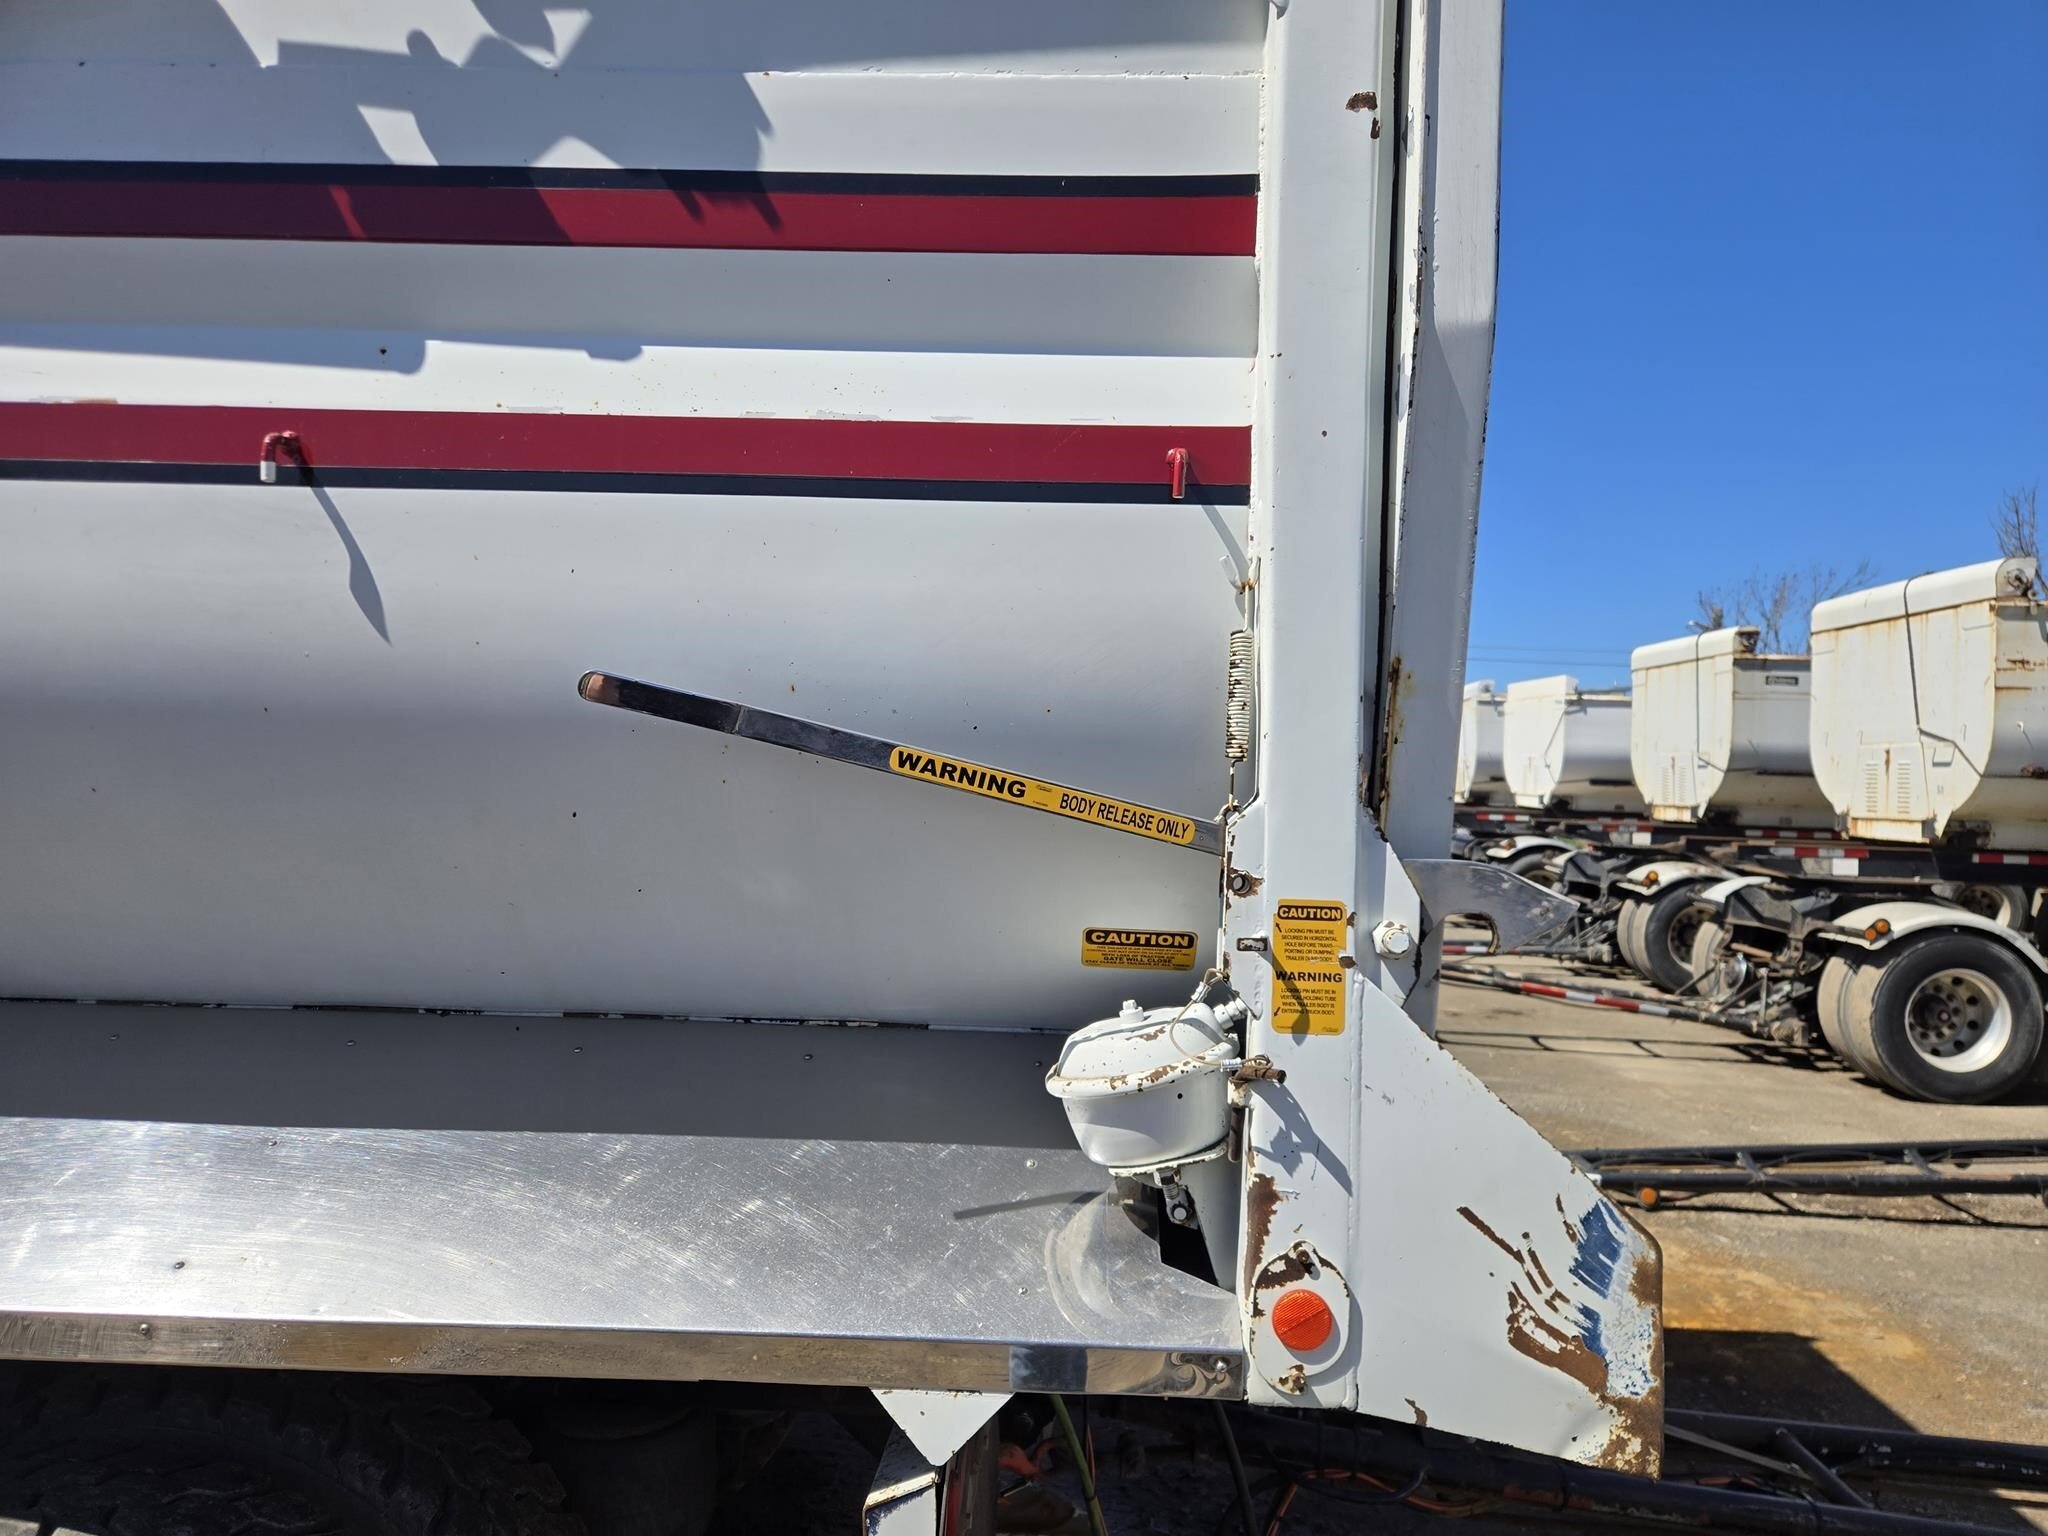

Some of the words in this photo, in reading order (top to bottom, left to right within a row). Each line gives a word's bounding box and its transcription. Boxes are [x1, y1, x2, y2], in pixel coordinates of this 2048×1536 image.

[898, 750, 1026, 798] WARNING
[1059, 793, 1097, 816] BODY
[1097, 801, 1155, 831] RELEASE
[1156, 817, 1190, 840] ONLY
[1279, 907, 1341, 919] CAUTION
[1091, 932, 1189, 946] CAUTION
[1275, 970, 1342, 983] WARNING
